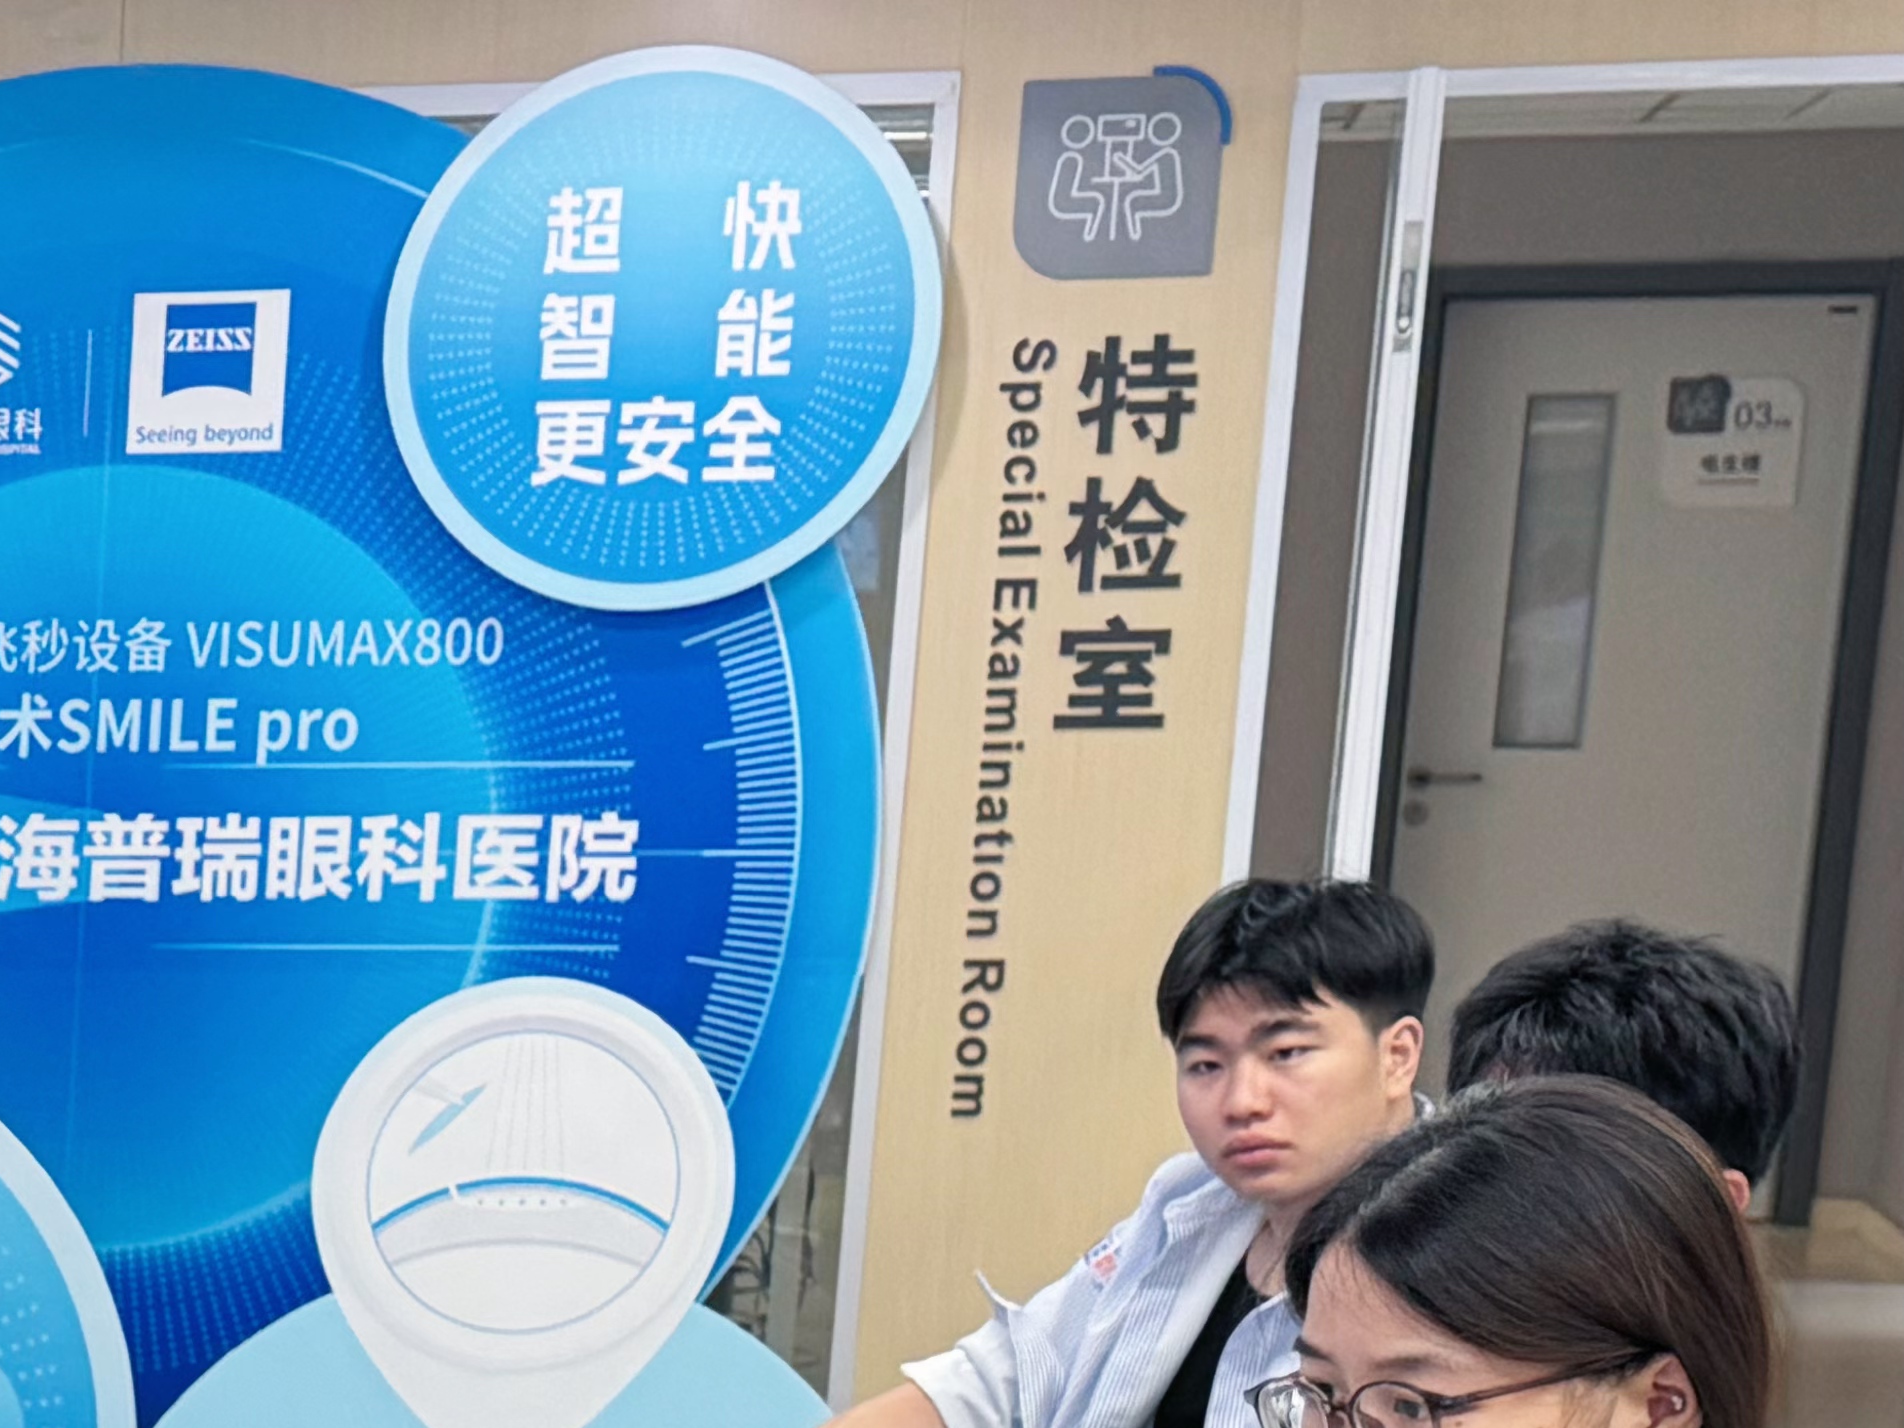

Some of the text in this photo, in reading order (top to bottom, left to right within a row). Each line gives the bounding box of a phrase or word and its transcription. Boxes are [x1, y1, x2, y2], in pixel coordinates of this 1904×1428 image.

[544, 179, 803, 276] 超 快
[166, 326, 253, 354] ZEISS
[538, 287, 796, 382] 智 能
[135, 420, 274, 446] Seeing beyond
[529, 394, 782, 488] 更安全
[1052, 333, 1197, 731] 特检室
[186, 617, 503, 669] VISUMAX800
[256, 708, 359, 766] pro
[949, 336, 1057, 1120] Special Examination Room
